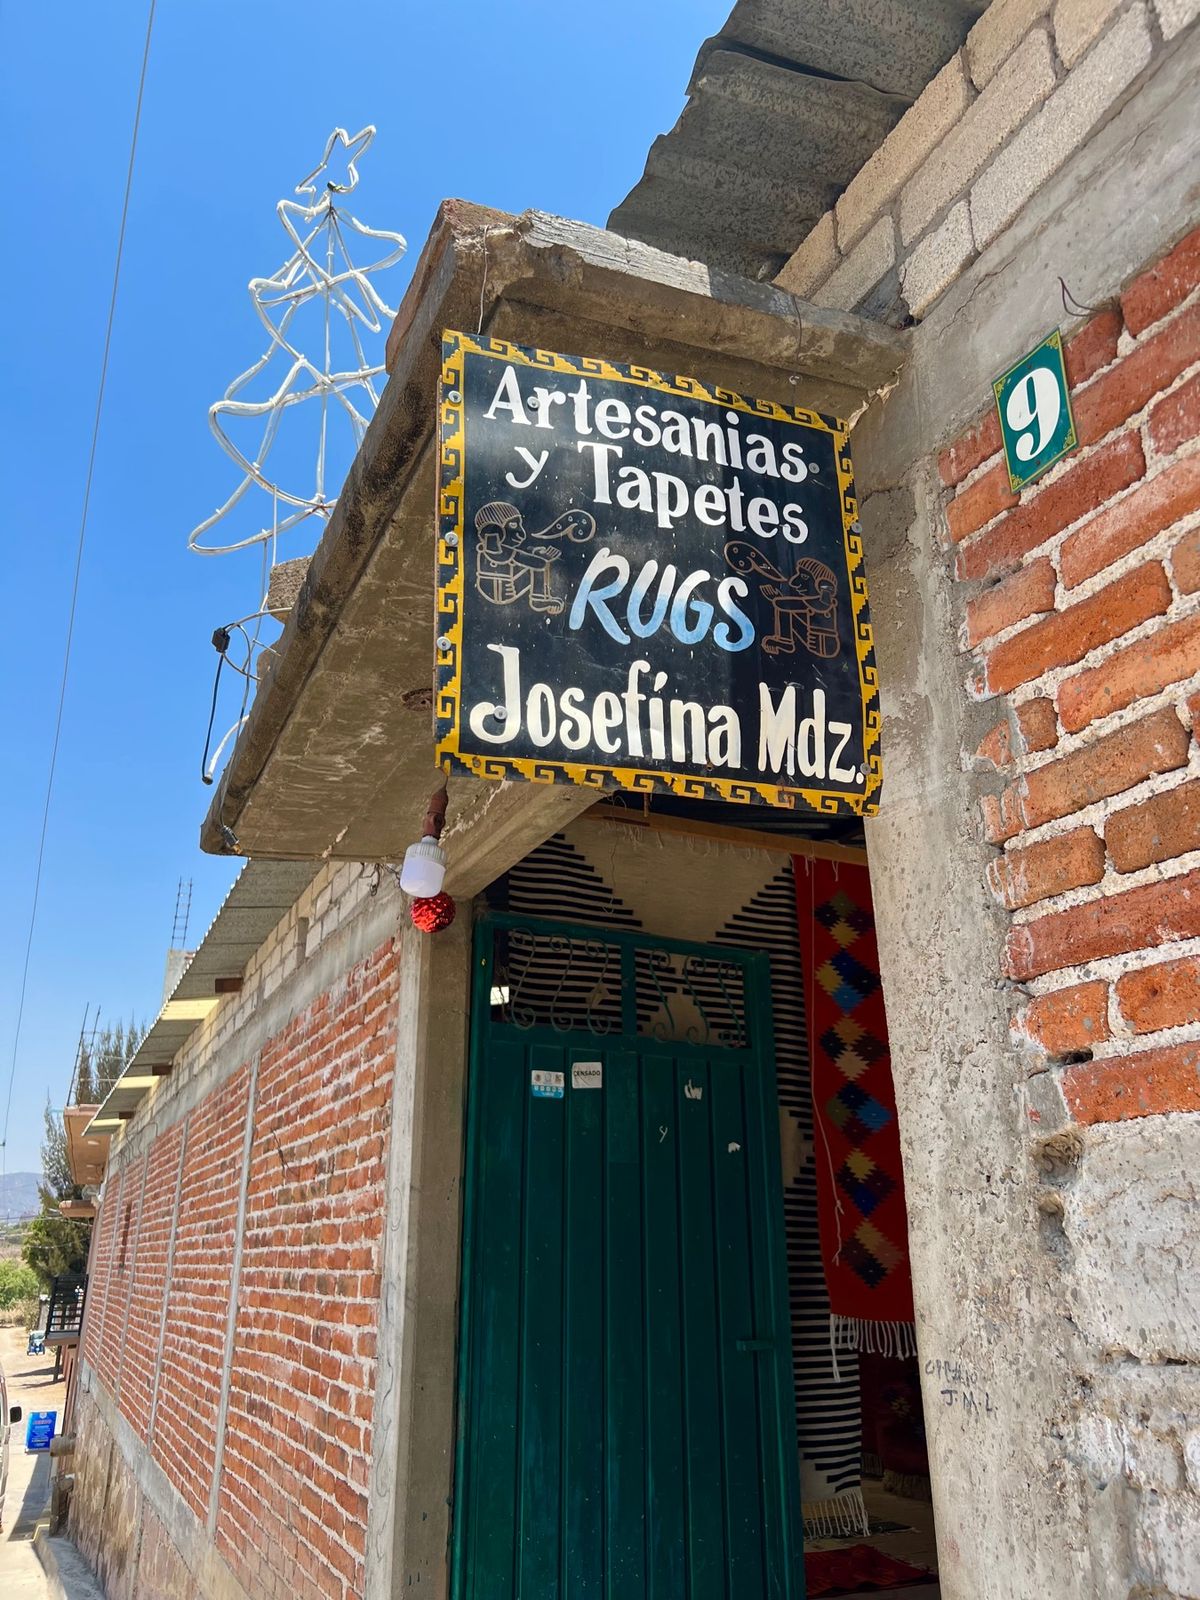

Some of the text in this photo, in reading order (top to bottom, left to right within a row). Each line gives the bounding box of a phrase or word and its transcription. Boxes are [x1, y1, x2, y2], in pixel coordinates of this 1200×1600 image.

[483, 365, 809, 484] Artesanias
[1006, 367, 1061, 462] 9
[505, 440, 809, 544] y Tapetes
[568, 547, 756, 652] RUGS
[757, 682, 864, 784] Mdz.
